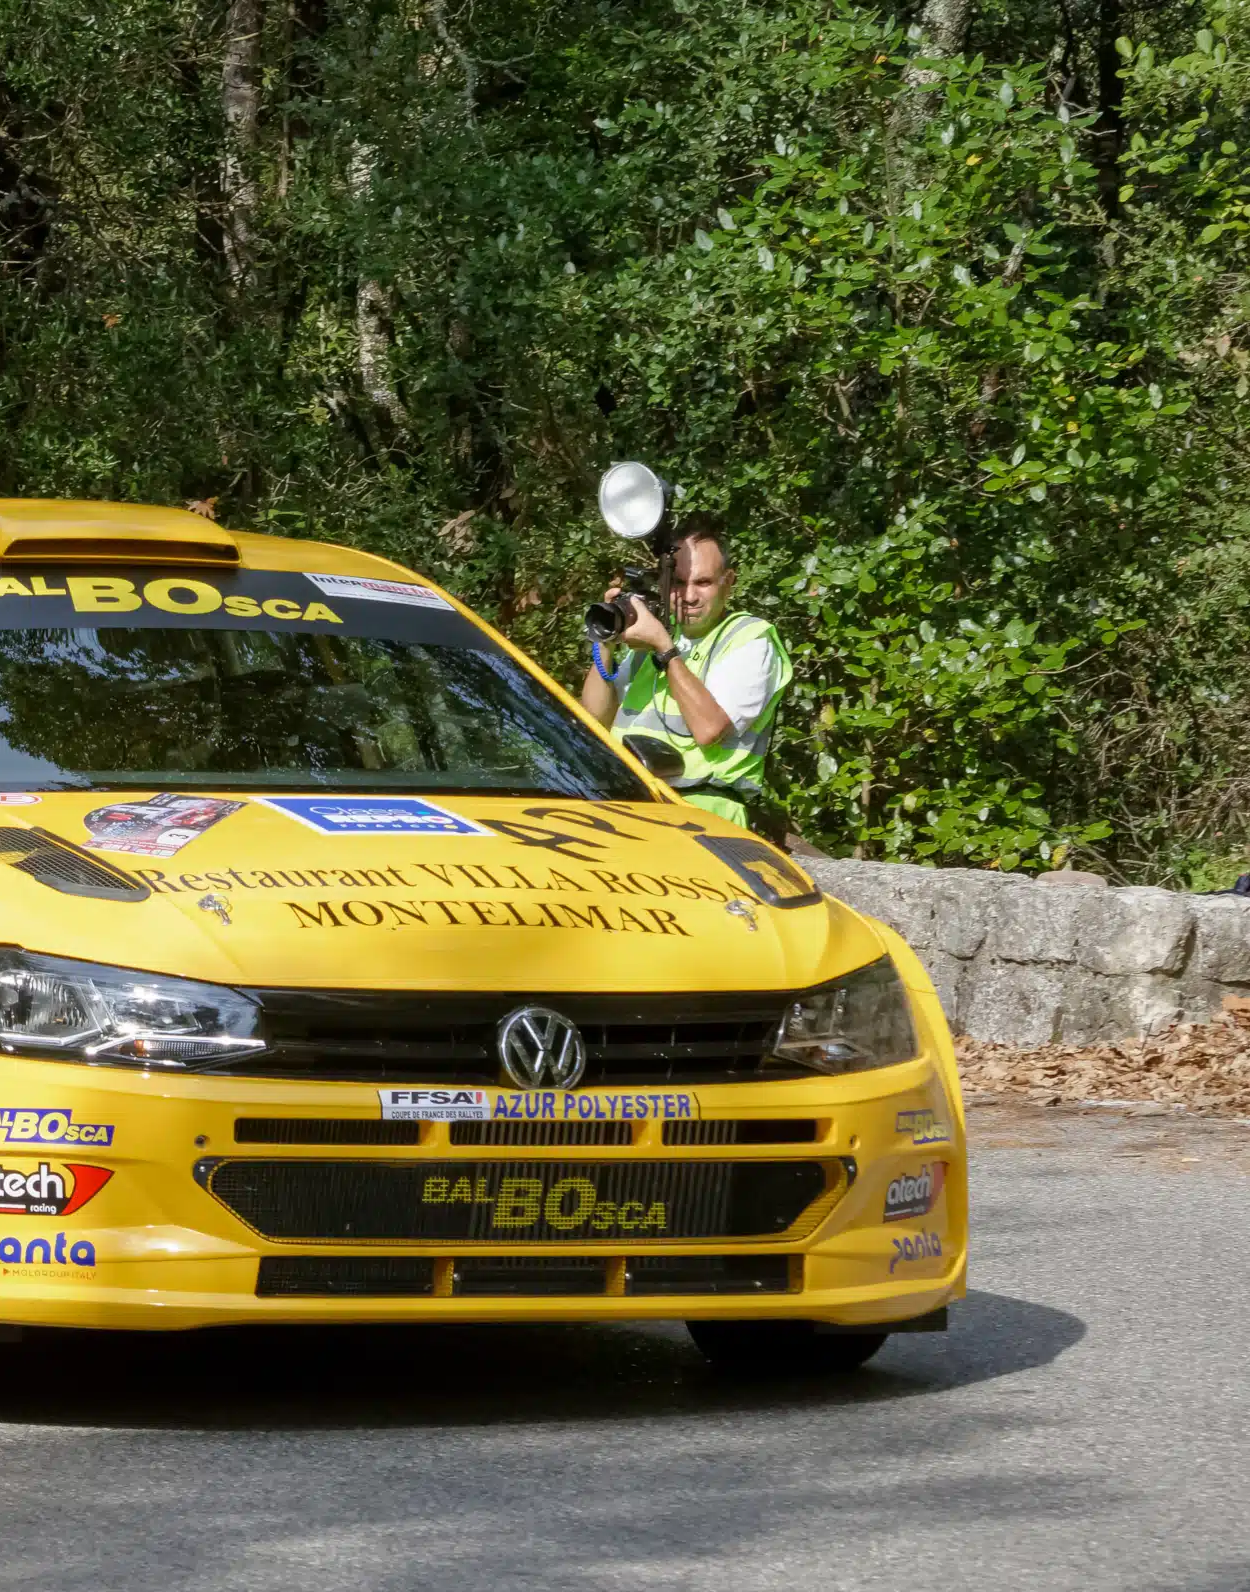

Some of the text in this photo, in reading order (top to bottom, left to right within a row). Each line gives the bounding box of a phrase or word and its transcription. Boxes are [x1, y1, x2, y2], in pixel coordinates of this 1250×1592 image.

[130, 863, 768, 906] Restaurant VILLA ROSSA
[283, 900, 694, 937] MONTELIMAR
[391, 1091, 474, 1105] FFSA
[493, 1092, 691, 1119] AZUR POLYESTER
[391, 1110, 411, 1119] COUPE
[412, 1110, 420, 1119] DE
[421, 1110, 444, 1119] FRANCE
[445, 1110, 457, 1119] DES
[29, 1203, 57, 1214] racing
[421, 1176, 667, 1230] BALBOSCA
